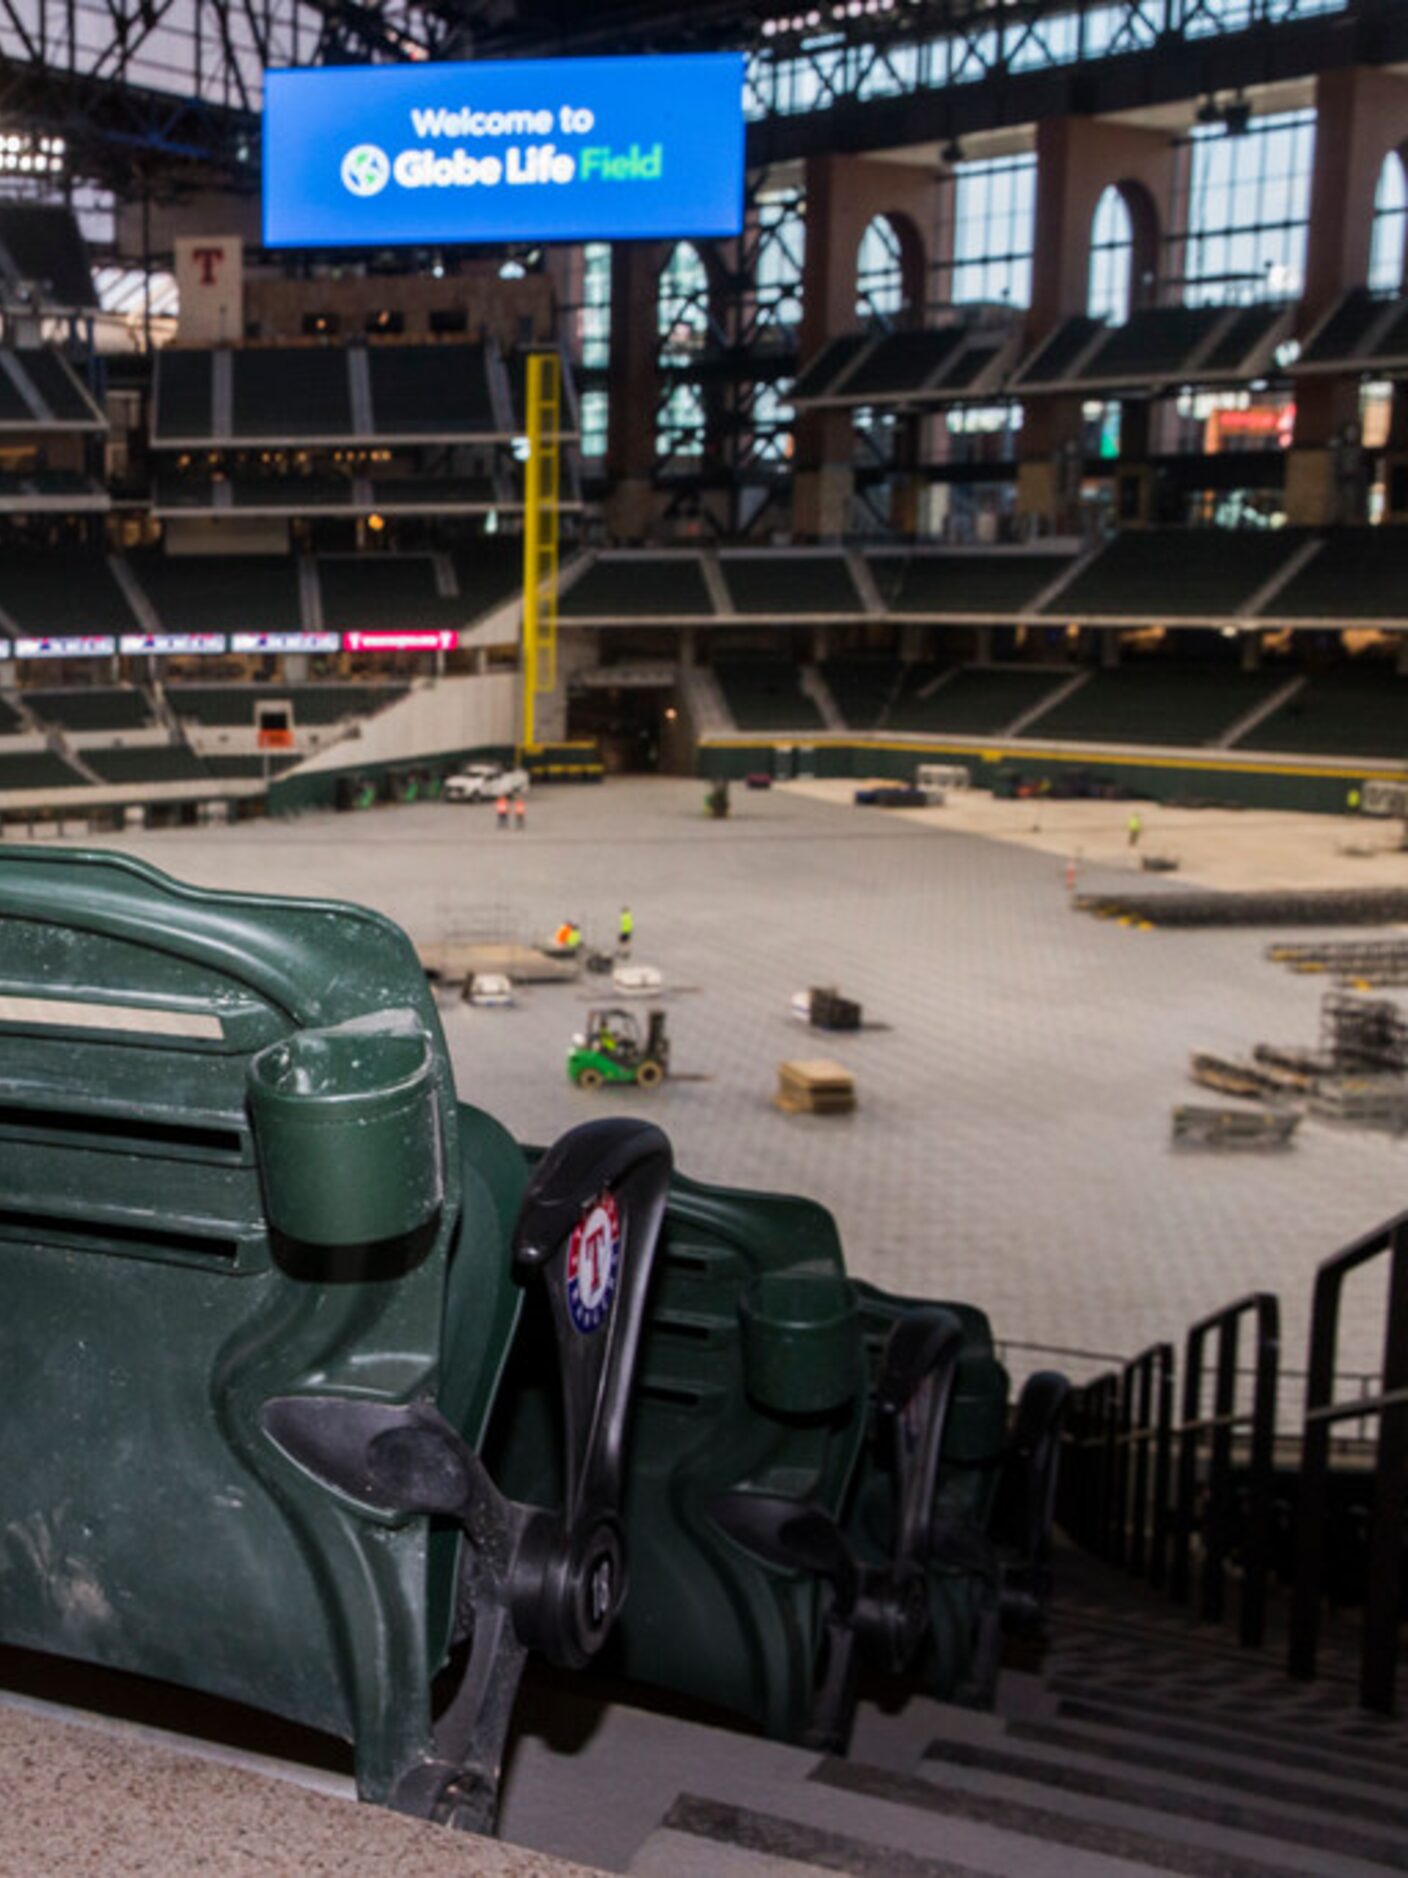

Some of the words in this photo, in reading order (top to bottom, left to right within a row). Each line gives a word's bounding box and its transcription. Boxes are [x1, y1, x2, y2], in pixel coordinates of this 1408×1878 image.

[411, 107, 553, 138] Welcome
[560, 105, 595, 134] to
[393, 147, 502, 188] Globe
[506, 144, 575, 184] Life
[579, 142, 663, 180] Field
[192, 248, 225, 287] T
